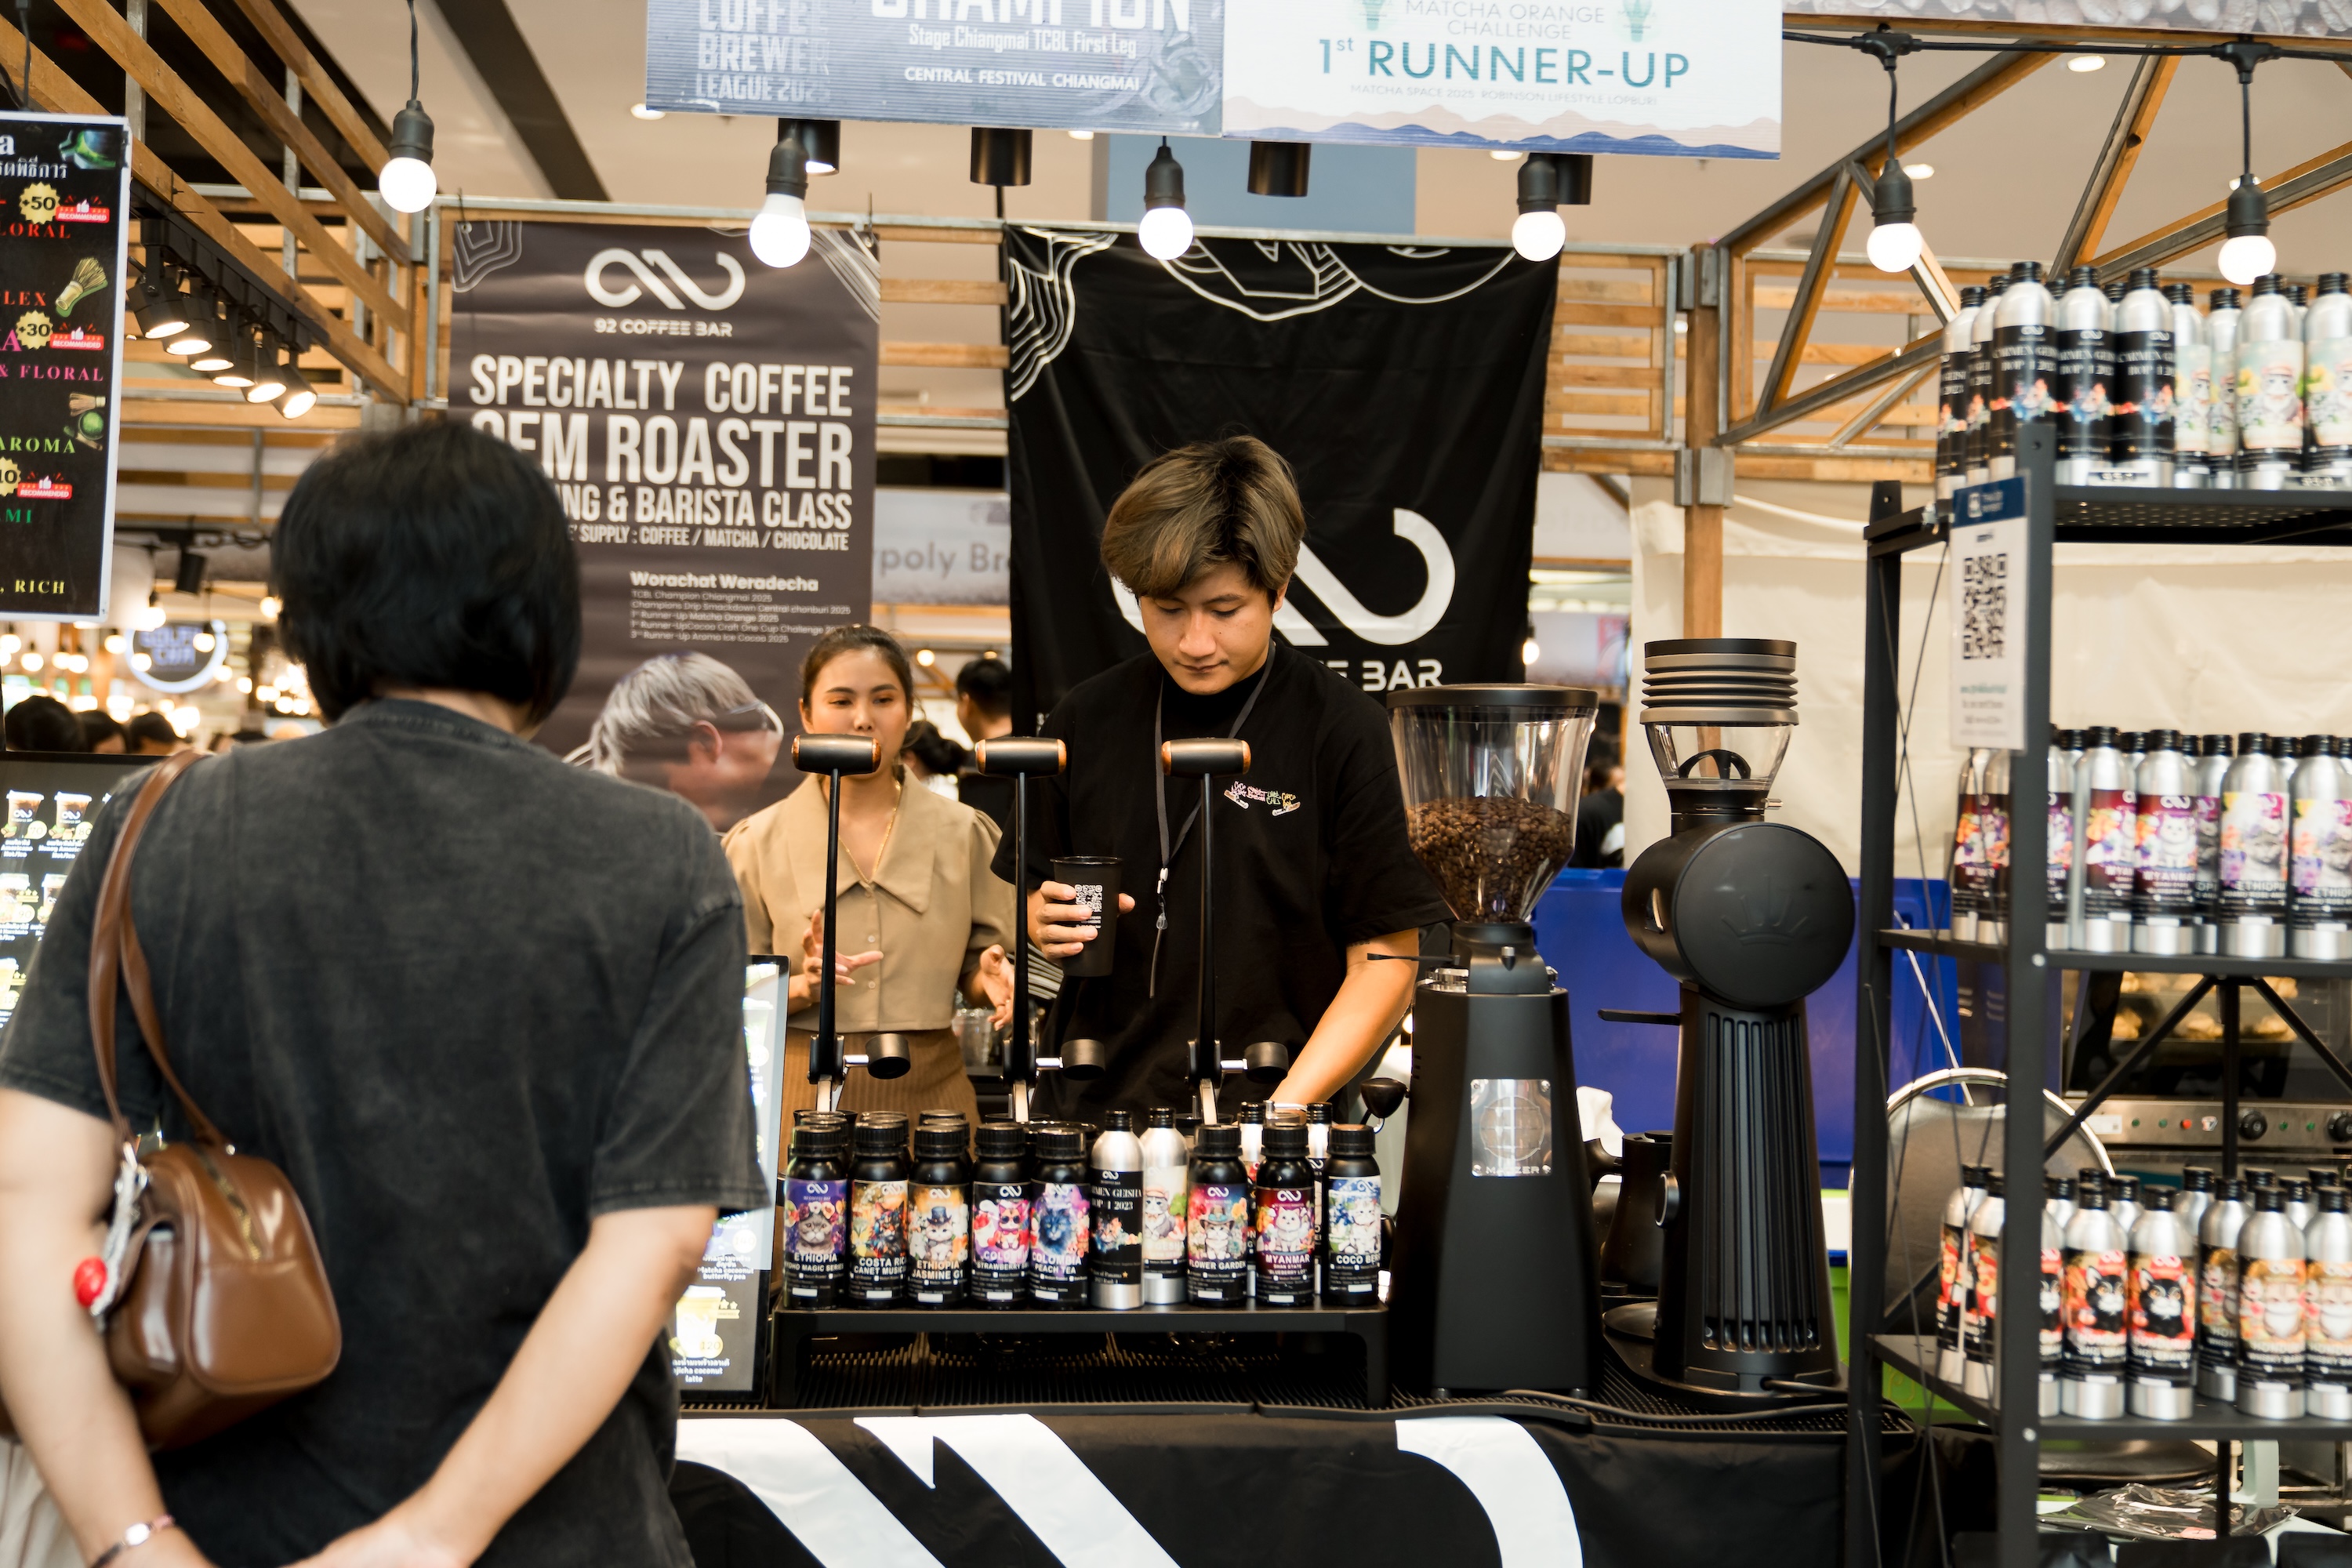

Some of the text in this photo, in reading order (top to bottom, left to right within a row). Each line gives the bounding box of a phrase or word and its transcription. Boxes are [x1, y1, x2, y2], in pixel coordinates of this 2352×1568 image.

[1405, 0, 1606, 24] MATCHA ORANGE
[1447, 20, 1573, 40] CHALLENGE
[909, 24, 1137, 59] Stage Chiangmai TCBL First Leg
[698, 33, 829, 75] BREWER
[1369, 39, 1690, 89] RUNNER-UP
[696, 73, 772, 100] LEAGUE
[904, 67, 1140, 91] CENTRAL FESTIVAL CHIANGMAI
[1351, 85, 1403, 96] MATCHA
[1406, 86, 1443, 98] SPACE
[1481, 89, 1544, 102] ROBINSON
[1548, 92, 1605, 104] LIFESTYLE
[1607, 94, 1657, 106] LOPBURI
[22, 196, 56, 211] +50
[58, 212, 107, 221] RECOMMENDED
[19, 324, 50, 337] +30
[593, 318, 733, 338] 92 COFFEE BAR
[52, 339, 102, 350] RECOMMENDED
[20, 364, 104, 382] FLORAL
[469, 354, 855, 417] SPECIALTY COFFEE
[605, 412, 855, 491] ROASTER
[20, 488, 70, 499] RECOMMENDED
[607, 486, 629, 524] &
[635, 486, 757, 527] BARISTA
[763, 491, 853, 530] CLASS
[0, 508, 33, 524] MI
[579, 524, 630, 544] SUPPLY
[640, 526, 691, 546] COFFEE
[703, 528, 760, 549] MATCHA
[772, 532, 850, 551] CHOCOLATE
[874, 541, 1011, 579] poly Br
[15, 579, 65, 596] RICH
[630, 571, 819, 592] Worachat Weradecha
[654, 591, 700, 602] Champion
[702, 592, 750, 604] Chiangmai
[751, 594, 772, 603] 2025
[631, 600, 681, 612] Champions
[683, 601, 702, 612] Drip
[702, 602, 757, 612] Smackdown
[757, 603, 789, 613] Central
[830, 606, 851, 615] 2025
[643, 611, 688, 622] Runner-Up
[688, 612, 724, 622] Matcha
[724, 614, 757, 624] Orange
[757, 615, 779, 623] 2025
[643, 630, 691, 642] Runner-Up
[691, 632, 722, 641] Aroma
[723, 633, 736, 641] Ice
[737, 634, 767, 643] Cocoa
[768, 634, 789, 644] 2025
[758, 624, 779, 635] Cup
[780, 625, 824, 637] Challenge
[1362, 659, 1443, 691] BAR
[793, 1251, 838, 1264] ETHIOPIA
[858, 1257, 892, 1268] COSTA
[916, 1259, 960, 1270] ETHIOPIA
[1032, 1252, 1082, 1266] COLOMBIA
[1218, 1260, 1247, 1270] GARDEN
[1265, 1253, 1311, 1264] MYANMAR
[1336, 1254, 1364, 1265] COCO
[801, 1264, 826, 1272] MAGIC
[882, 1265, 906, 1276] MUSIC
[912, 1269, 952, 1280] JASMINE
[1035, 1263, 1059, 1274] PEACH
[1060, 1265, 1076, 1275] TEA
[700, 1341, 721, 1351] 120
